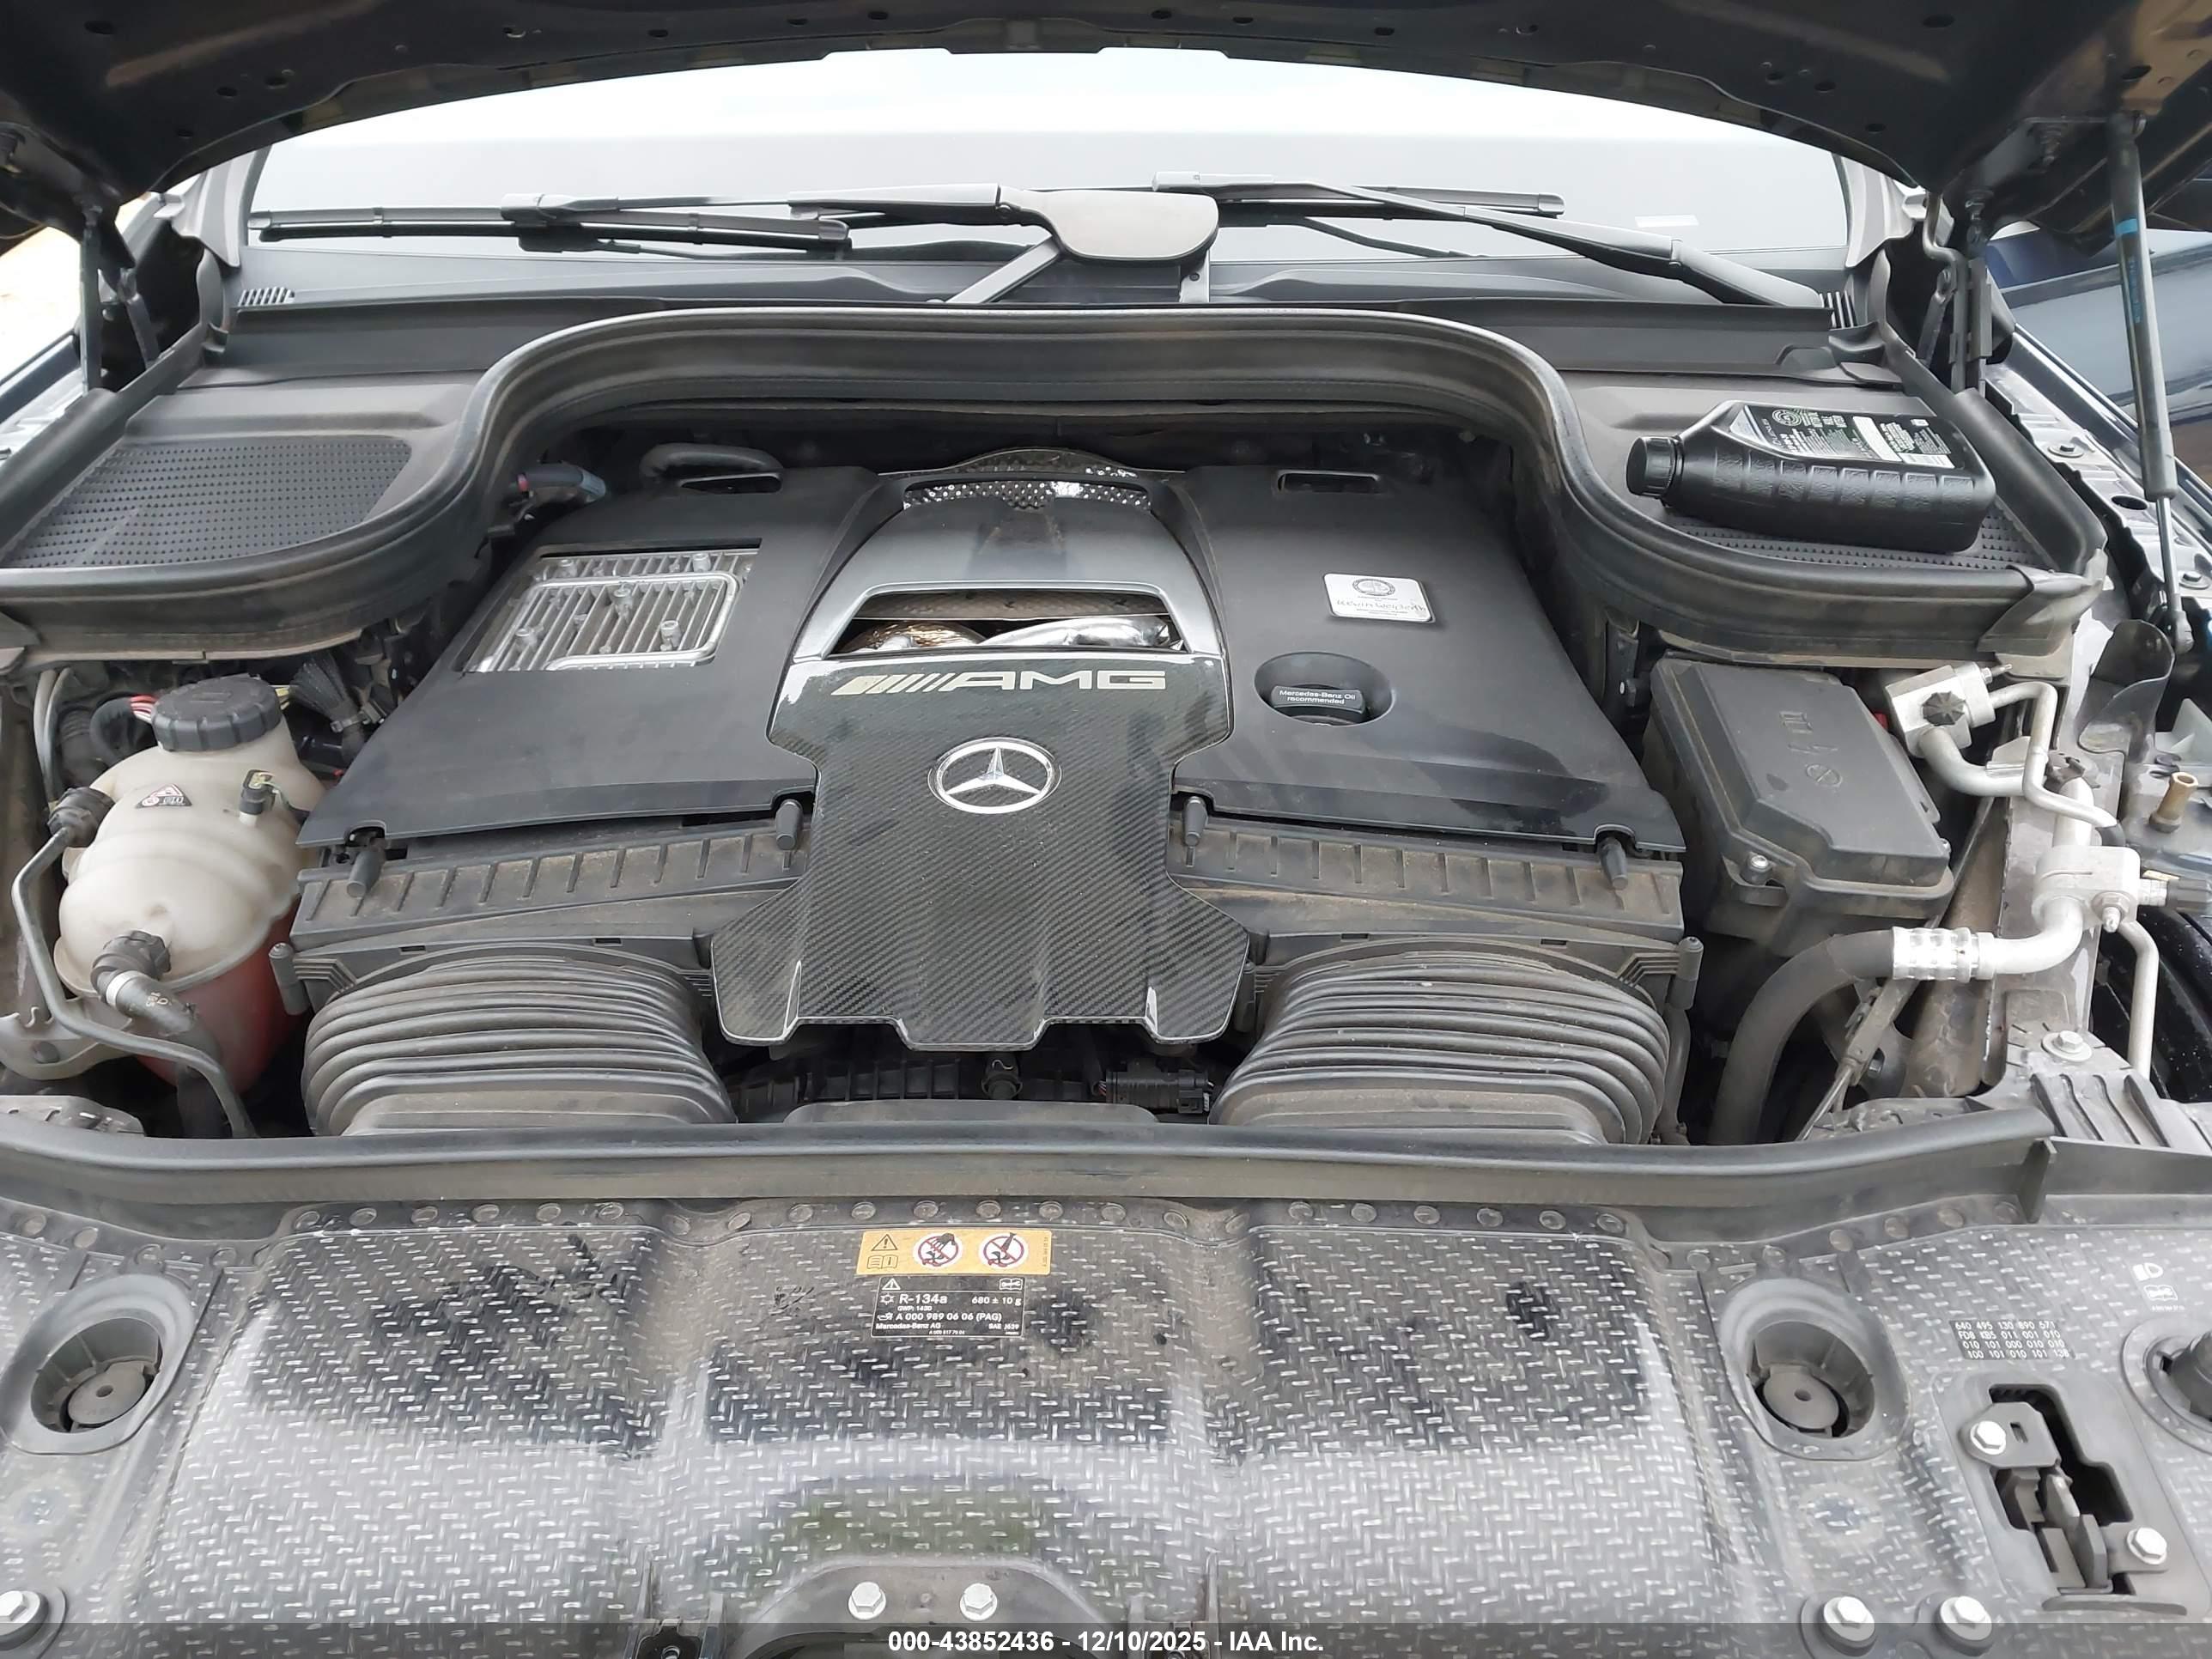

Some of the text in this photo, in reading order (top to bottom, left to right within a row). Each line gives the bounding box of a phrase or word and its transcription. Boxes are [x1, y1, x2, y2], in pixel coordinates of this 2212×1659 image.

[939, 670, 1166, 690] AMG
[1279, 690, 1342, 699] Mercedes-Benz
[899, 1293, 948, 1304] R-134a
[976, 1313, 1002, 1322] (PAG)
[1955, 1322, 1972, 1330] 640
[1977, 1321, 1993, 1330] 495
[1997, 1321, 2014, 1329] 130
[2039, 1320, 2056, 1328] 571
[2001, 1331, 2018, 1340] 011
[2022, 1330, 2039, 1339] 001
[2043, 1330, 2061, 1339] 010
[1962, 1339, 2065, 1349] 010 101 000 010 010
[1967, 1350, 1984, 1358] 100
[1989, 1350, 2005, 1358] 101
[2009, 1349, 2027, 1358] 010
[2032, 1349, 2048, 1358] 101
